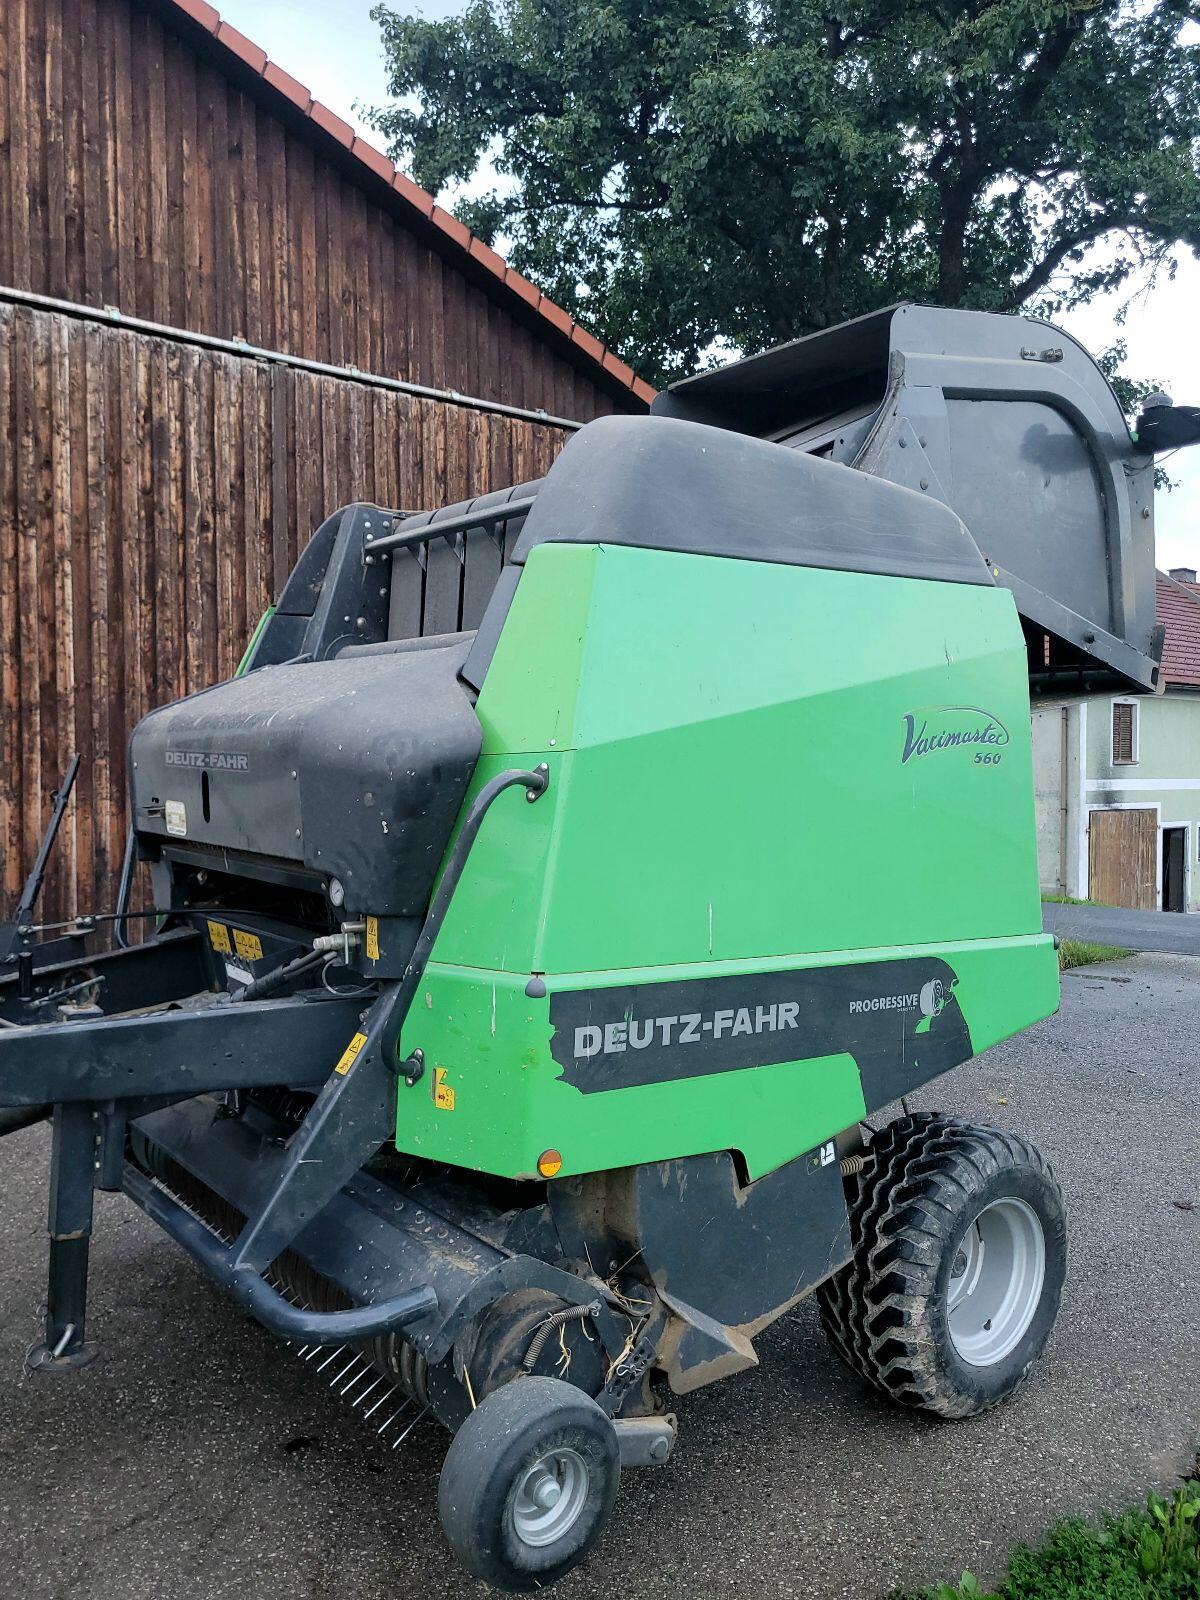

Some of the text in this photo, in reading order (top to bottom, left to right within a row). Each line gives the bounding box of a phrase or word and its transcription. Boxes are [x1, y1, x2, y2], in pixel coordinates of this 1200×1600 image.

[165, 751, 248, 770] DEUTZ-FAHR
[973, 752, 1001, 765] 560
[849, 993, 919, 1014] PROGRESSIVE
[573, 1001, 800, 1058] DEUTZ-FAHR
